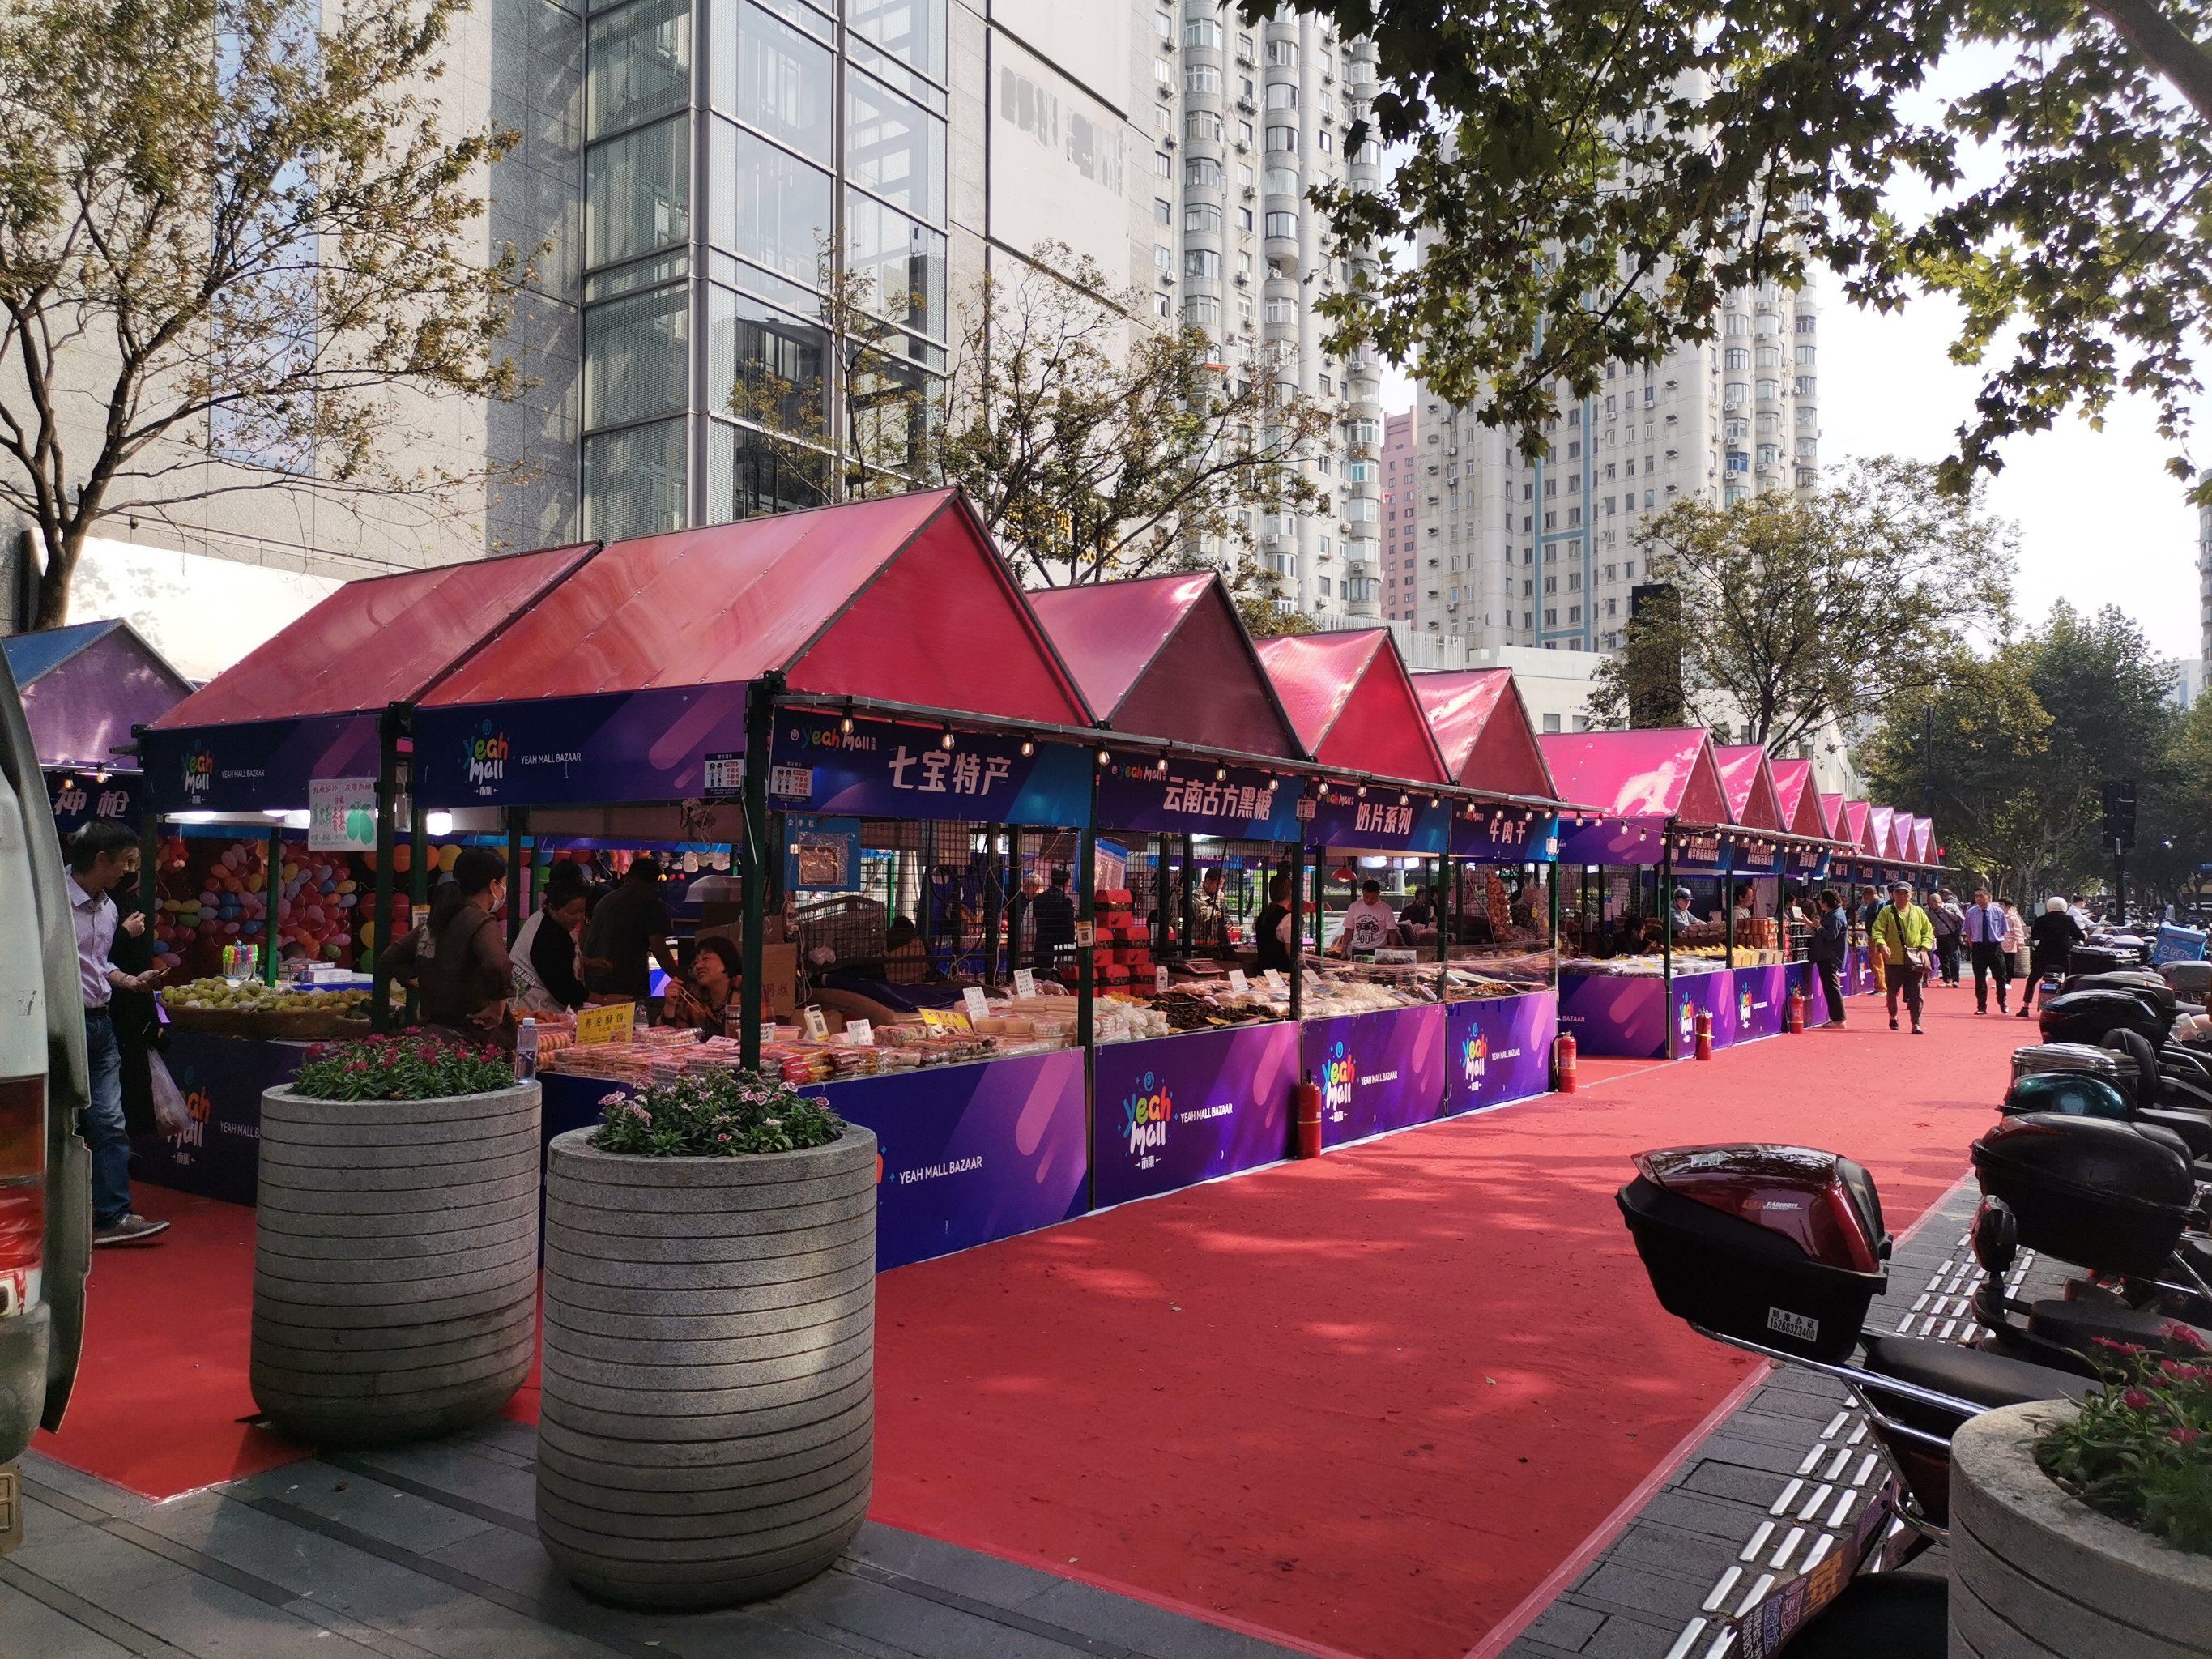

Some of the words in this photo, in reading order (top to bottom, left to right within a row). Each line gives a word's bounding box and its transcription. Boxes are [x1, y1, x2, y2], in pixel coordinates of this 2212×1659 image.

[521, 755, 538, 765] YEAH
[538, 753, 556, 764] MALL
[556, 752, 582, 763] BAZAAR
[888, 745, 1012, 797] 七宝特产
[1162, 776, 1274, 821] 云南古方黑糖
[1354, 801, 1413, 835] 奶片系列
[1489, 818, 1527, 844] 牛肉干
[1562, 1015, 1585, 1024] BAZAAR
[1180, 1111, 1196, 1124] YEAH
[1196, 1107, 1212, 1120] MALL
[1211, 1102, 1234, 1117] BAZAAR
[220, 1120, 237, 1134] YEAH
[237, 1123, 254, 1137] MALL
[899, 1168, 923, 1185] YEAH
[924, 1162, 948, 1179] MALL
[949, 1155, 983, 1175] BAZAAR
